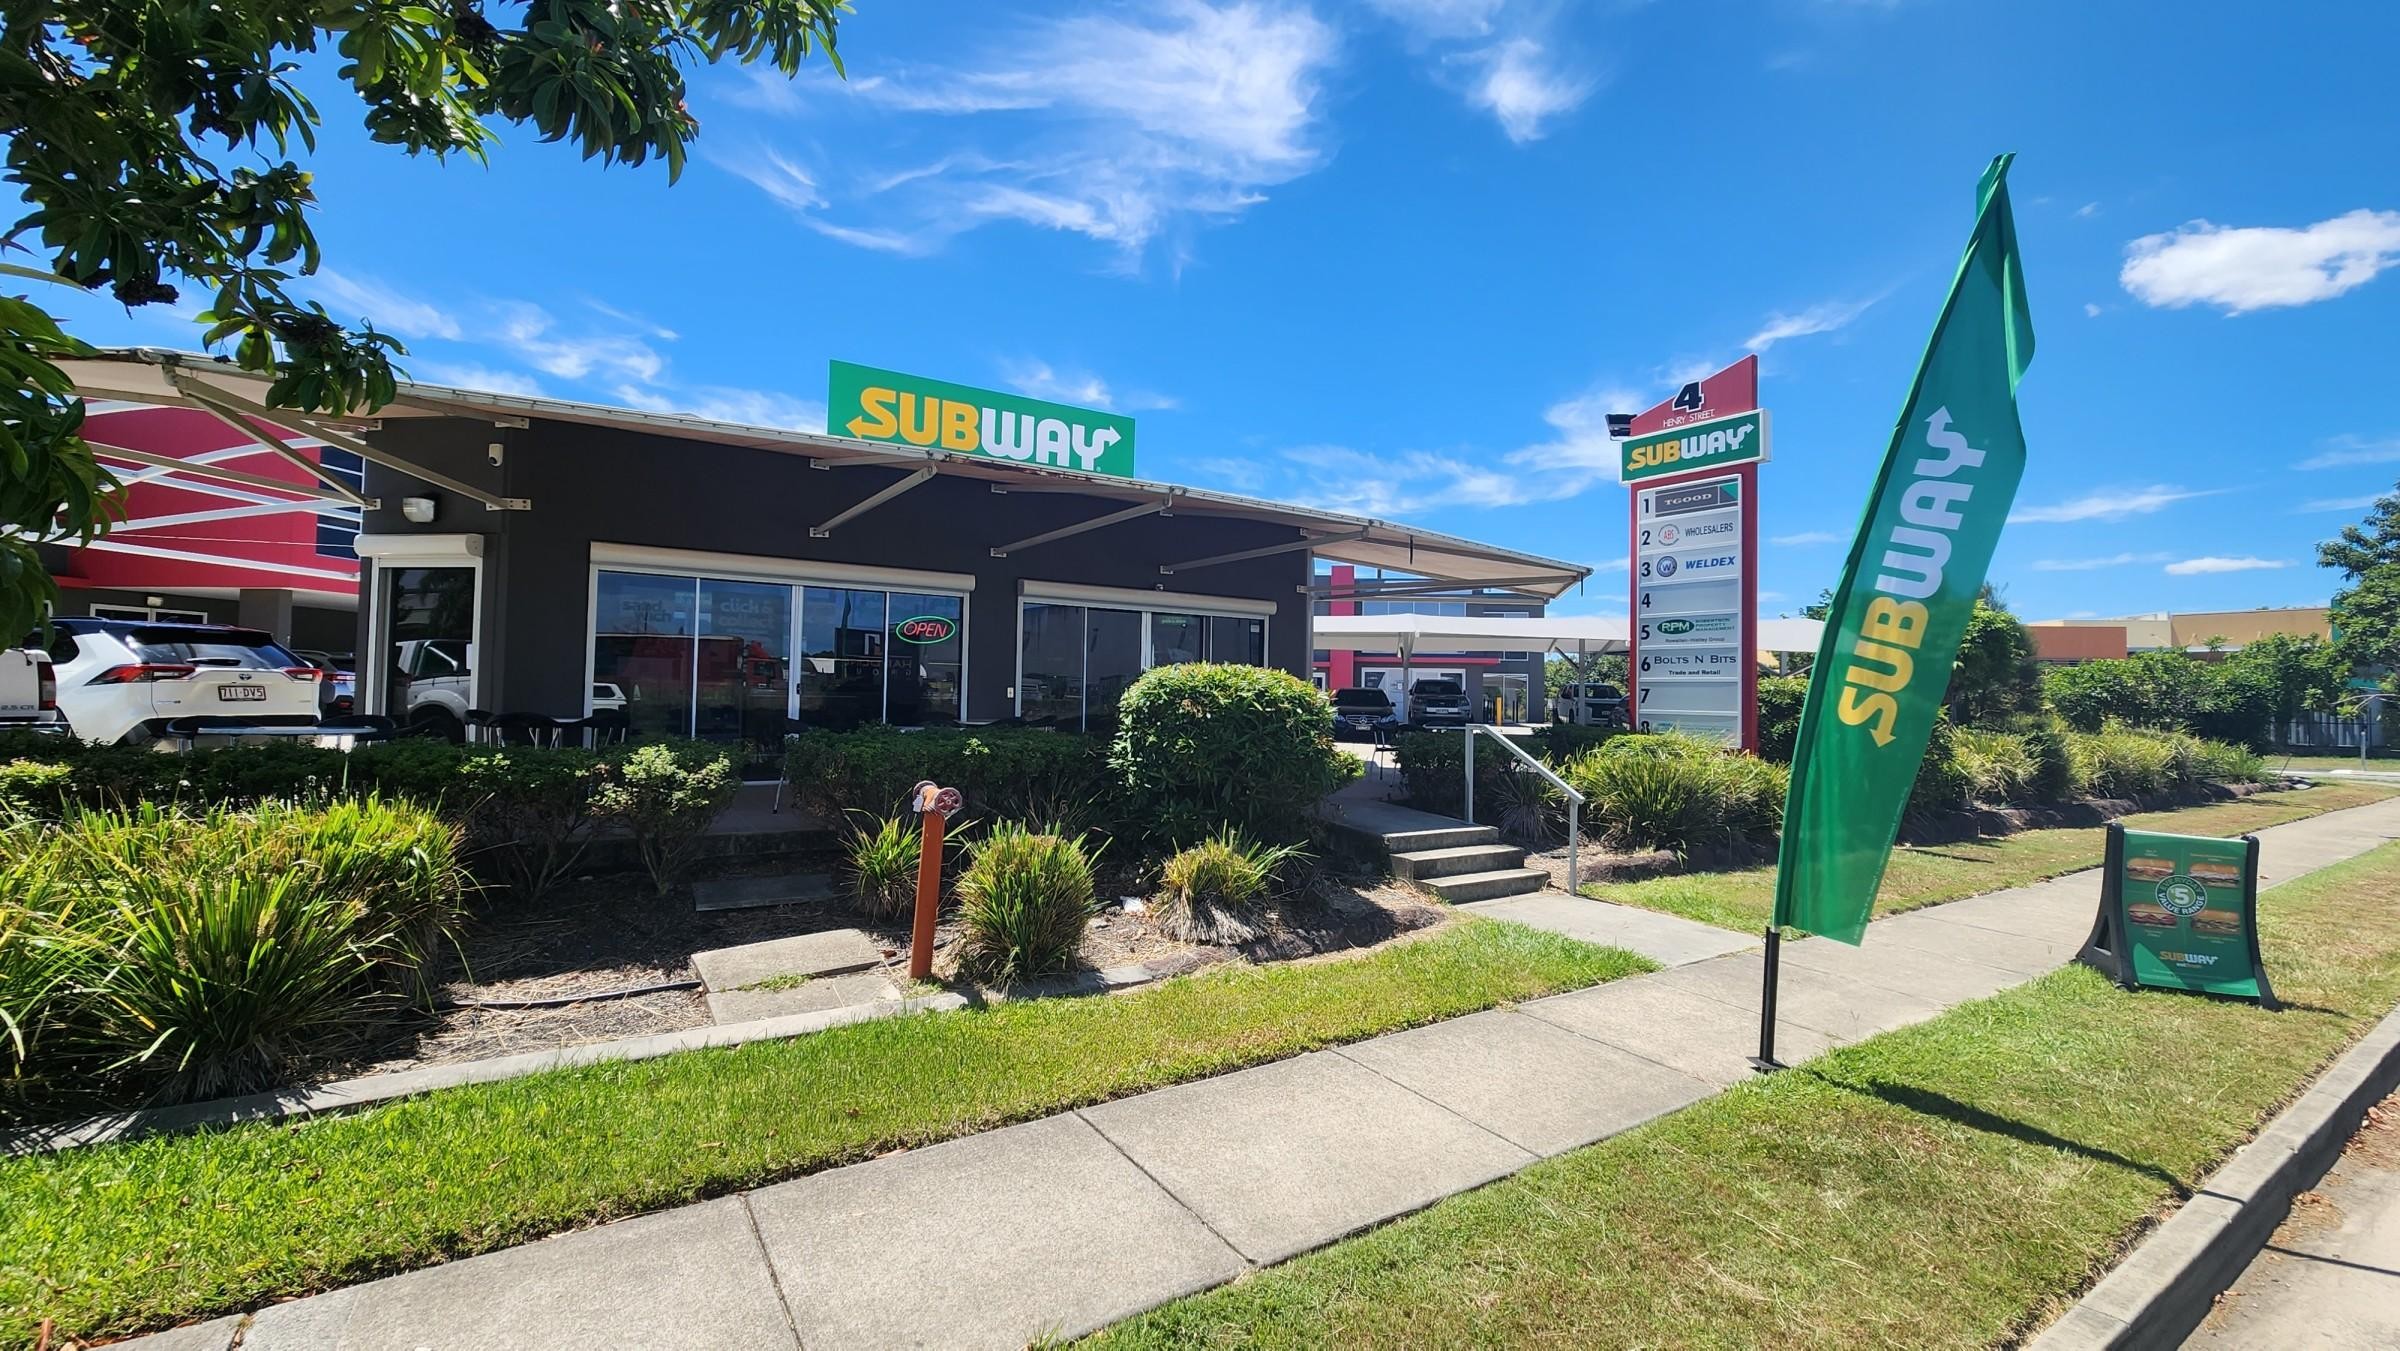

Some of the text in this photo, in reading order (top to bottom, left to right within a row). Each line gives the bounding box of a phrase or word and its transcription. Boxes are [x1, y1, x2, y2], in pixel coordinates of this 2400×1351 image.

[1672, 380, 1704, 413] 4
[1663, 408, 1716, 428] HENRY STREET
[846, 386, 1122, 472] SUBWAY
[1626, 422, 1755, 472] SUBWAY
[1643, 493, 1713, 514] 1 TGOOD
[1641, 530, 1651, 546] 2
[1684, 522, 1734, 537] WHOLESALERS
[1641, 562, 1651, 577] 3
[1685, 555, 1736, 570] WELDEX
[1837, 405, 1987, 748] SUBWAY
[1641, 593, 1652, 608] 4
[903, 621, 948, 638] OPEN
[1641, 625, 1650, 640] 5
[1661, 621, 1690, 632] RPM
[1641, 655, 1737, 671] 6 BOLTS N BITS
[1641, 689, 1650, 703] 7
[2158, 892, 2205, 915] VALUE RANGE
[2159, 951, 2219, 966] SUBWAY
